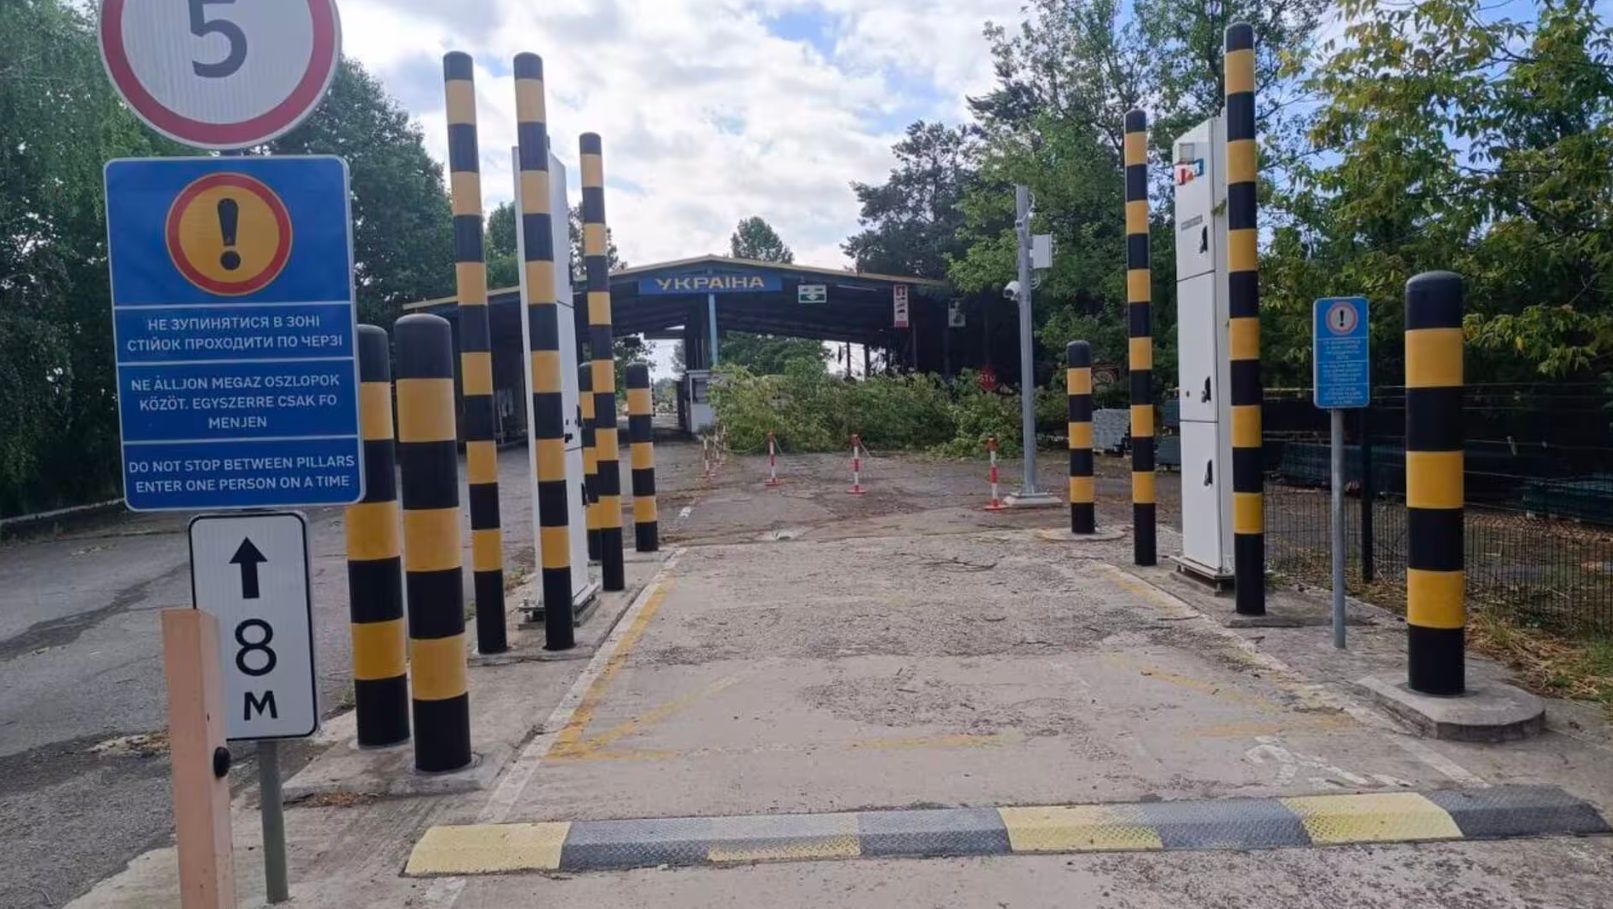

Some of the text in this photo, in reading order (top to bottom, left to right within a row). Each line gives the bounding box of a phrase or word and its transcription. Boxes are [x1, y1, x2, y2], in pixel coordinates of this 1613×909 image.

[189, 0, 248, 78] 5
[148, 315, 320, 330] НЕ ЗУПИНЯТИСЯ В ЗОНІ
[127, 335, 343, 351] СТІЙОК ПРОХОДИТИ ПО ЧЕРЗІ
[131, 379, 151, 391] NE
[212, 376, 261, 389] MEGAZ
[265, 374, 340, 387] OSZLOPOK
[193, 396, 274, 409] EGYSZERRE
[278, 395, 315, 407] CSAK
[319, 394, 337, 406] FO
[208, 416, 267, 429] MENJEN
[129, 455, 355, 473] DO NOT STOP BETWEEN PILLARS
[136, 475, 350, 493] ENTER ONE PERSON ON A TIME
[234, 618, 277, 677] 8
